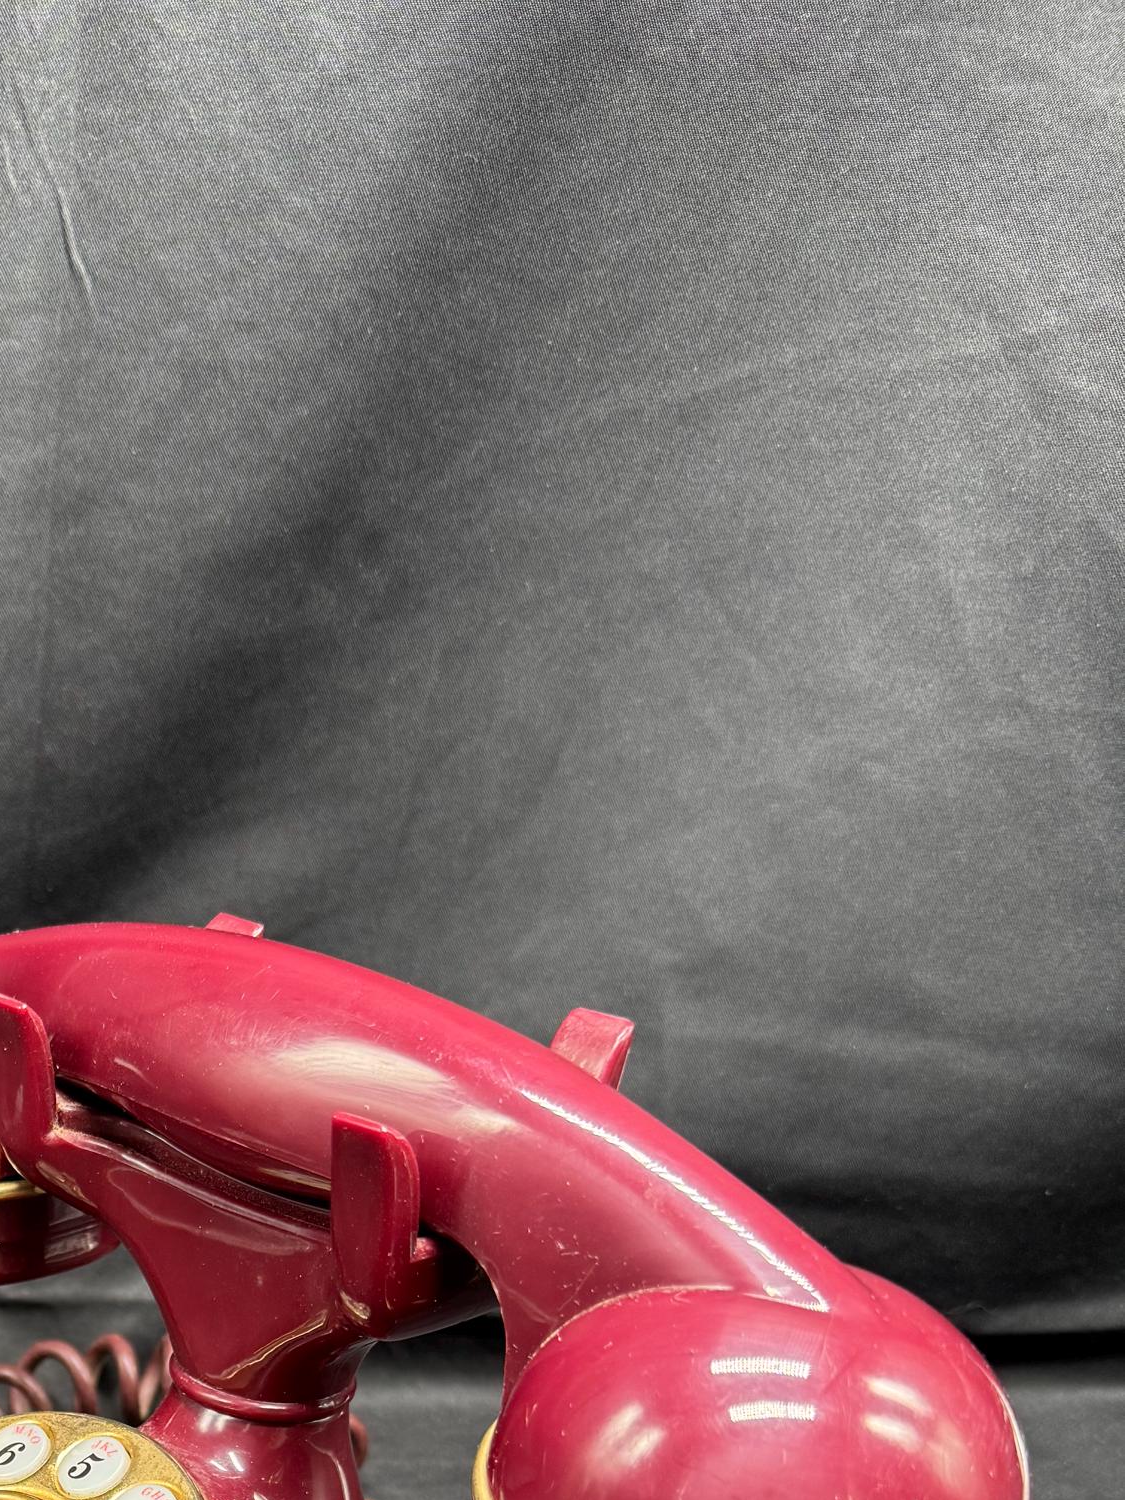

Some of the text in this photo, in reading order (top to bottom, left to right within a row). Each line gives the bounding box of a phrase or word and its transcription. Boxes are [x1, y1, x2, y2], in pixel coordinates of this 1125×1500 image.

[12, 1425, 42, 1445] MNO
[91, 1439, 119, 1457] JKL
[68, 1453, 105, 1480] 5
